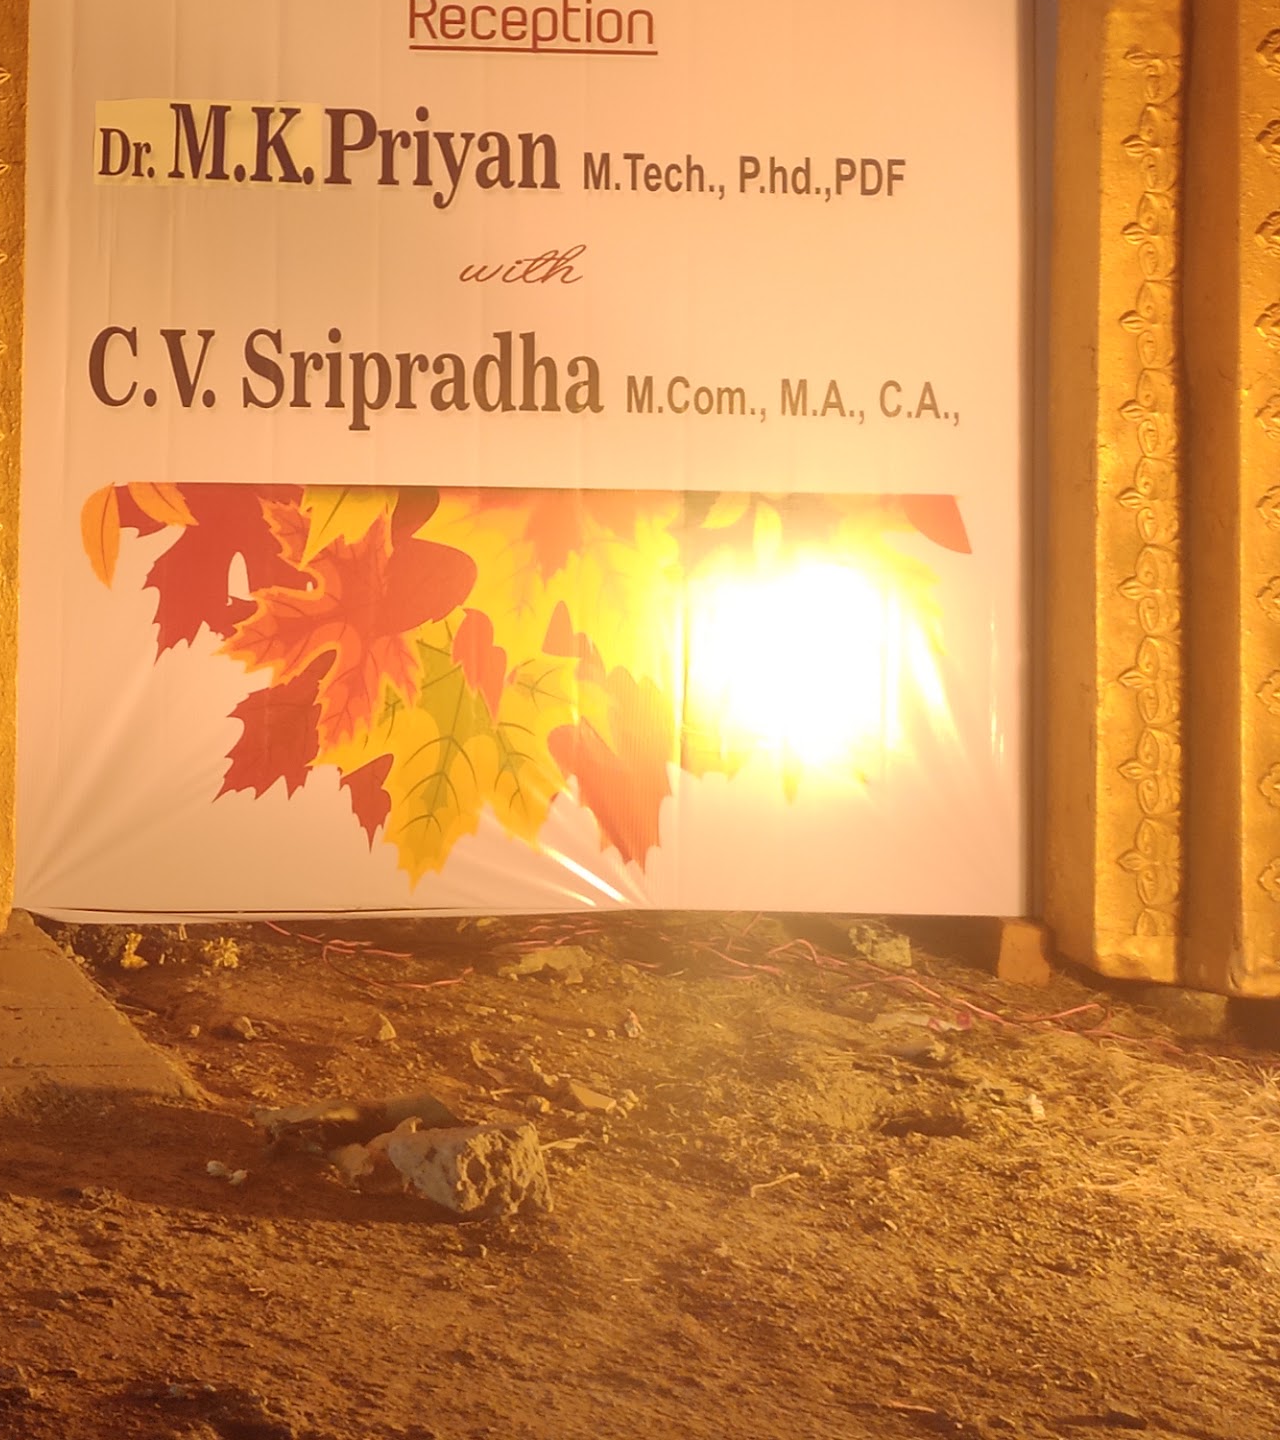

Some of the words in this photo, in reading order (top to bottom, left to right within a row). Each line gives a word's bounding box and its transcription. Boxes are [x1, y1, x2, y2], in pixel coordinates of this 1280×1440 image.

[582, 151, 726, 200] M.Tech.,
[458, 243, 587, 285] with
[88, 326, 217, 409] C.V.
[241, 327, 605, 432] Sripradha
[626, 375, 768, 422] M.Com.,
[779, 378, 867, 424] M.A.,
[878, 380, 961, 427] C.A.,
